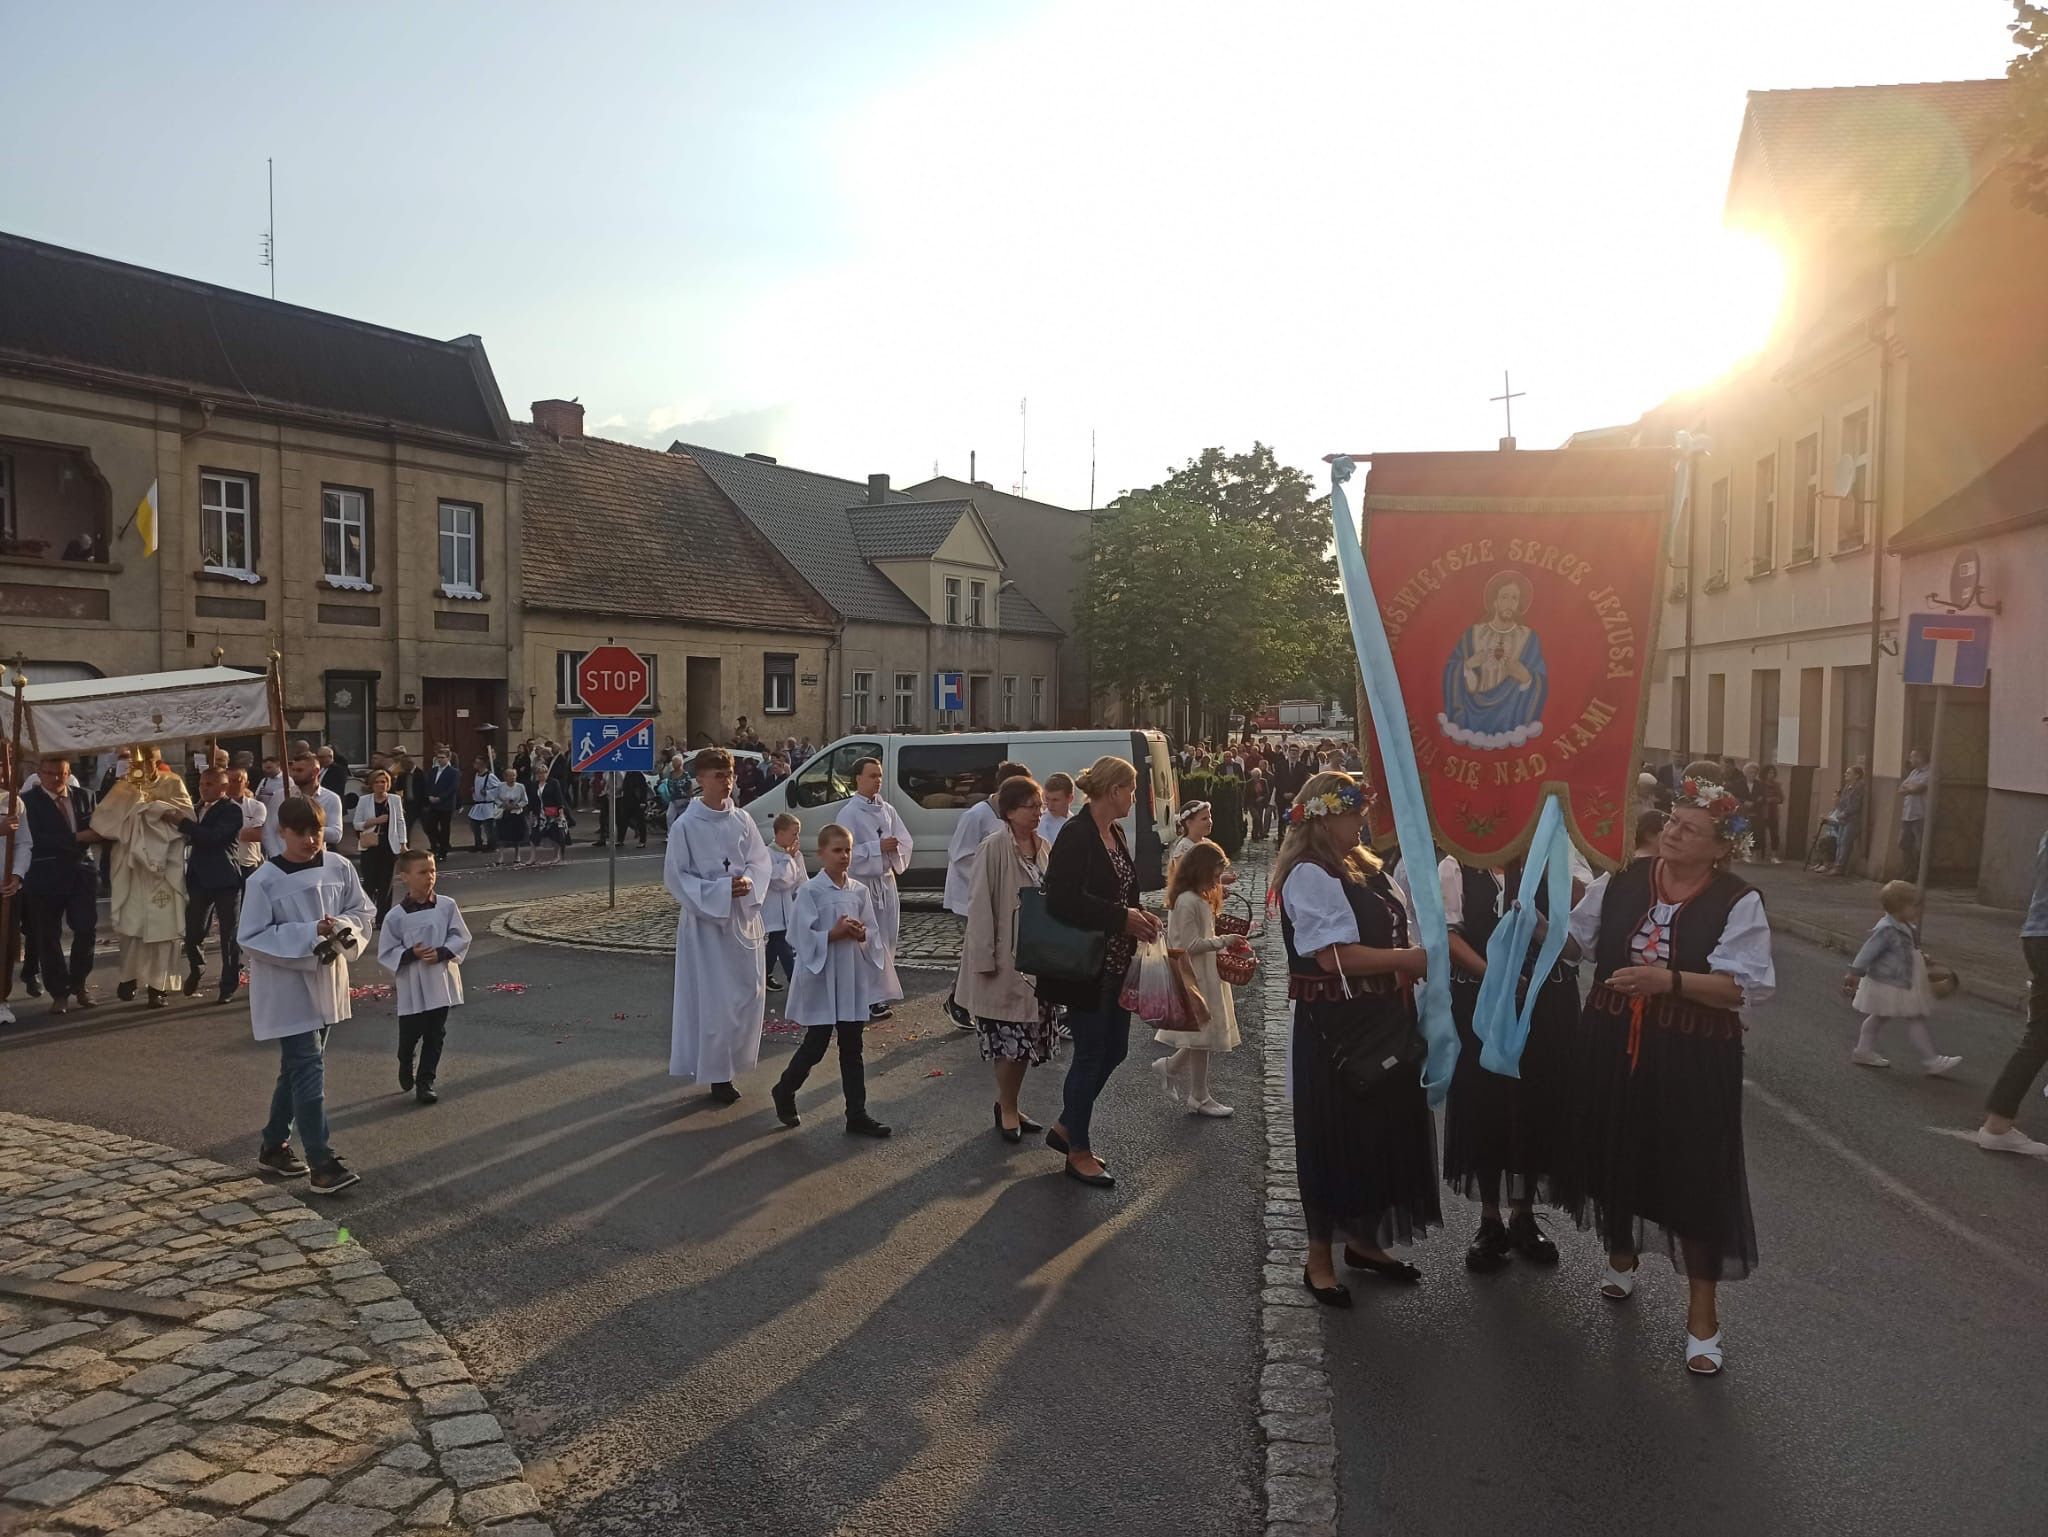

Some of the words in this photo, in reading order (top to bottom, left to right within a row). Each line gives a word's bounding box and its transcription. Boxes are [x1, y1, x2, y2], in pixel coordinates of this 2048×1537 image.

[1508, 538, 1592, 585] SERCE
[1588, 584, 1635, 680] JEZUSA
[586, 670, 641, 691] STOP
[1444, 755, 1480, 790] SIĘ
[1494, 753, 1546, 785] NAD
[1553, 697, 1616, 760] NAMI
